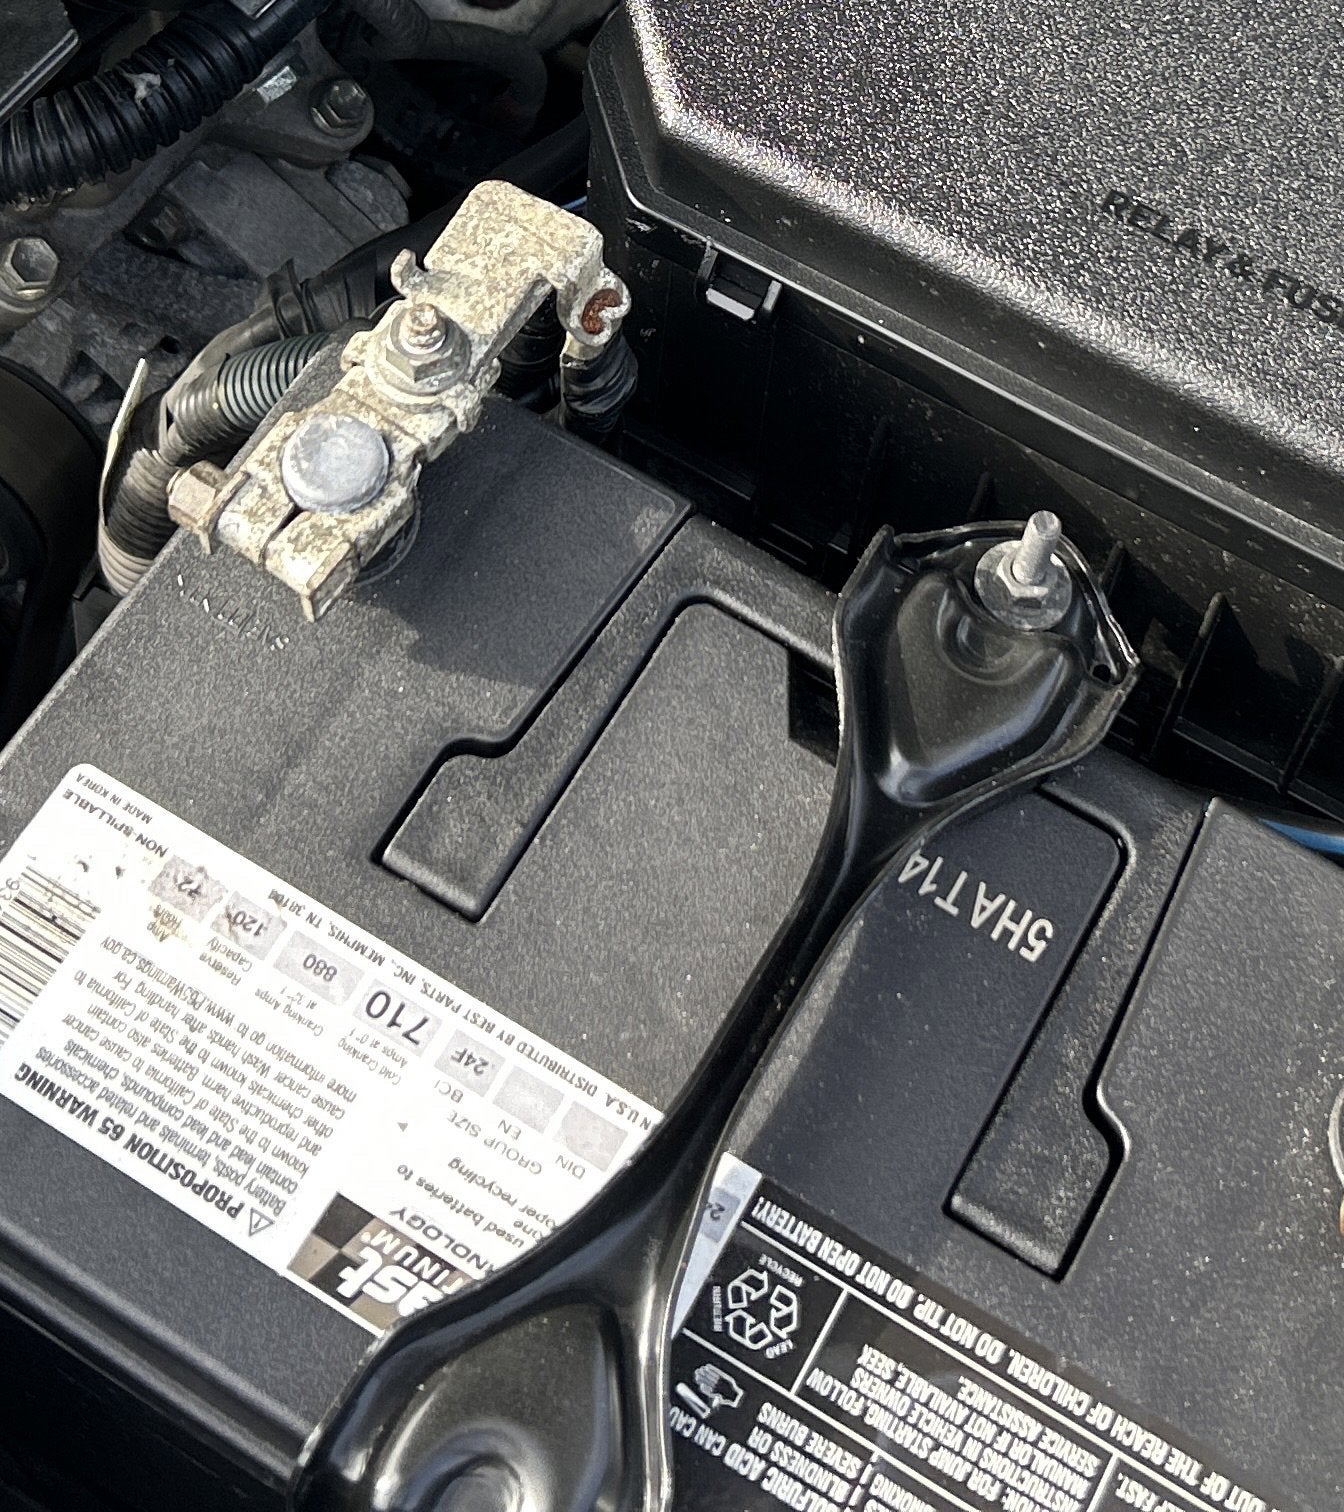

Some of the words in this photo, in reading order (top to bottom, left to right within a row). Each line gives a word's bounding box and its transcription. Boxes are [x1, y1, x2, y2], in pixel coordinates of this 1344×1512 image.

[1105, 190, 1226, 260] RELAY
[74, 771, 110, 799] KOREA
[108, 792, 122, 806] IN
[120, 799, 153, 825] MADE
[304, 910, 324, 928] TN
[897, 849, 1054, 963] 5HAT14
[143, 919, 171, 944] Amp
[196, 950, 243, 986] Reserve
[204, 934, 254, 973] Capacity
[300, 950, 339, 984] 880
[71, 968, 88, 986] to
[109, 968, 133, 990] For
[83, 976, 137, 1017] California
[251, 984, 284, 1011] Amps
[415, 977, 463, 1014] PARTS,
[59, 1011, 100, 1044] cancer
[85, 1002, 127, 1035] contain
[133, 1007, 150, 1025] of
[146, 1015, 179, 1043] State
[177, 1010, 208, 1037] after
[234, 1020, 250, 1038] to
[280, 1001, 326, 1037] Cranking
[361, 986, 433, 1046] 710
[462, 1007, 496, 1034] BEST
[96, 1034, 133, 1064] cause
[124, 1026, 151, 1051] also
[175, 1034, 198, 1056] the
[204, 1027, 241, 1058] hands
[248, 1027, 267, 1046] go
[495, 1028, 515, 1046] BY
[32, 1045, 100, 1096] accessories
[60, 1038, 120, 1083] chemicals
[128, 1055, 145, 1073] to
[148, 1041, 200, 1081] Batteries
[195, 1046, 211, 1063] to
[208, 1054, 249, 1087] known
[238, 1049, 273, 1078] Wash
[263, 1039, 326, 1085] information
[449, 1042, 490, 1077] 24F
[514, 1038, 598, 1097] DISTRIBUTED
[12, 1061, 100, 1126] WARNING
[115, 1071, 186, 1124] compounds,
[141, 1063, 196, 1106] California
[245, 1077, 304, 1121] chemicals
[324, 1077, 357, 1104] more
[432, 1077, 464, 1104] BCI
[95, 1085, 139, 1121] related
[191, 1095, 209, 1114] of
[205, 1104, 239, 1133] State
[229, 1091, 300, 1144] reproductive
[309, 1091, 346, 1121] cause
[96, 1115, 126, 1143] 65
[133, 1108, 161, 1134] and
[180, 1113, 210, 1140] lead
[235, 1123, 258, 1146] the
[301, 1112, 334, 1140] other
[496, 1117, 522, 1140] EN
[156, 1123, 213, 1167] terminals
[205, 1129, 232, 1154] and
[228, 1143, 257, 1170] lead
[255, 1135, 272, 1153] to
[296, 1135, 322, 1158] and
[482, 1131, 544, 1176] GROUP
[121, 1132, 246, 1219] PROPOSITION
[206, 1152, 248, 1189] posts,
[253, 1159, 299, 1197] contain
[267, 1143, 310, 1178] known
[394, 1162, 414, 1180] to
[553, 1152, 587, 1180] DIN
[240, 1176, 288, 1217] Battery
[446, 1155, 519, 1208] recycling
[413, 1175, 484, 1225] batteries
[482, 1218, 525, 1251] used
[748, 1194, 825, 1253] BATTERY!
[756, 1252, 804, 1287] RECYCLE
[814, 1235, 863, 1276] OPEN
[855, 1259, 893, 1295] NOT
[883, 1277, 916, 1310] DO
[908, 1291, 948, 1329] TIP.
[935, 1308, 981, 1349] NOT
[765, 1338, 793, 1358] LEAD
[854, 1342, 899, 1381] SEEK
[971, 1330, 1007, 1365] DO
[802, 1365, 868, 1417] FOLLOW
[846, 1365, 914, 1417] OWNERS
[886, 1361, 973, 1427] AVAILABLE,
[998, 1347, 1094, 1418] CHILDREN.
[753, 1399, 813, 1448] BURNS
[949, 1374, 1044, 1443] ASSISTANCE.
[1083, 1399, 1117, 1432] OF
[691, 1422, 728, 1457] CAN
[744, 1425, 775, 1455] OR
[904, 1401, 968, 1452] VEHICLE
[961, 1410, 1000, 1445] NOT
[991, 1428, 1014, 1453] IF
[1106, 1412, 1173, 1466] REACH
[720, 1440, 768, 1482] ACID
[801, 1429, 865, 1480] SEVERE
[925, 1442, 974, 1483] JUMP
[959, 1436, 984, 1462] IN
[1005, 1437, 1035, 1466] OR
[1035, 1426, 1102, 1479] SERVICE
[1159, 1445, 1207, 1487] THE
[758, 1464, 841, 1512] ULFURIC
[765, 1438, 853, 1503] BLINDNESS
[963, 1439, 1082, 1512] INSTRUCTIONS
[964, 1466, 1002, 1502] FOR
[1024, 1448, 1092, 1500] MANUAL
[1197, 1467, 1232, 1502] OF
[1108, 1471, 1160, 1512] FAST.
[1221, 1482, 1268, 1512] OUT
